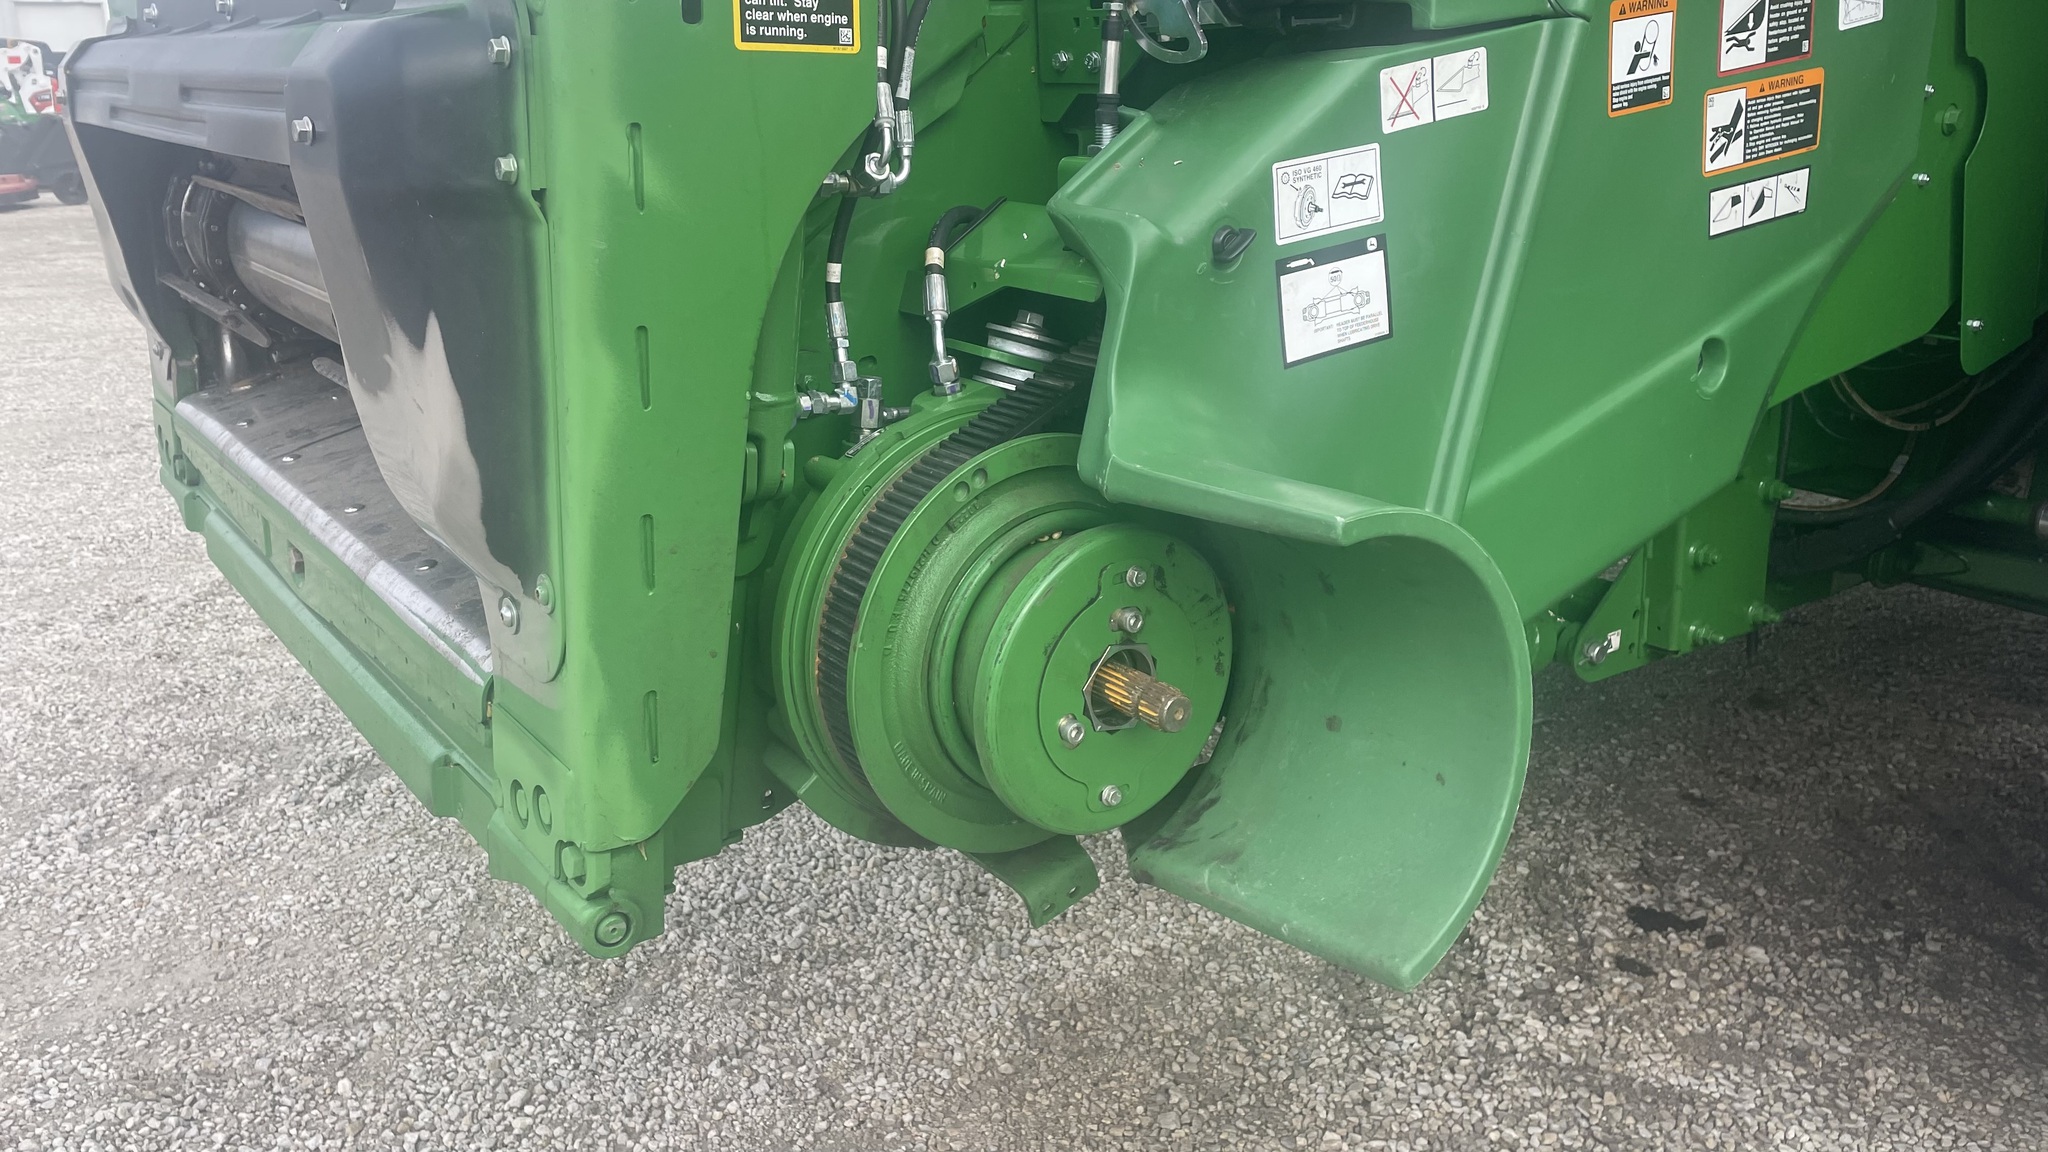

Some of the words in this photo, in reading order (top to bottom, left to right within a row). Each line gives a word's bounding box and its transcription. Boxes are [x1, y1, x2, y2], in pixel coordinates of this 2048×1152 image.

[1628, 0, 1669, 13] WARNING
[745, 8, 775, 21] clear
[777, 10, 808, 23] when
[810, 12, 849, 26] engine
[745, 23, 757, 35] is
[759, 25, 808, 40] running.
[1768, 74, 1804, 91] WARNING
[1292, 172, 1322, 184] SYNTHETIC
